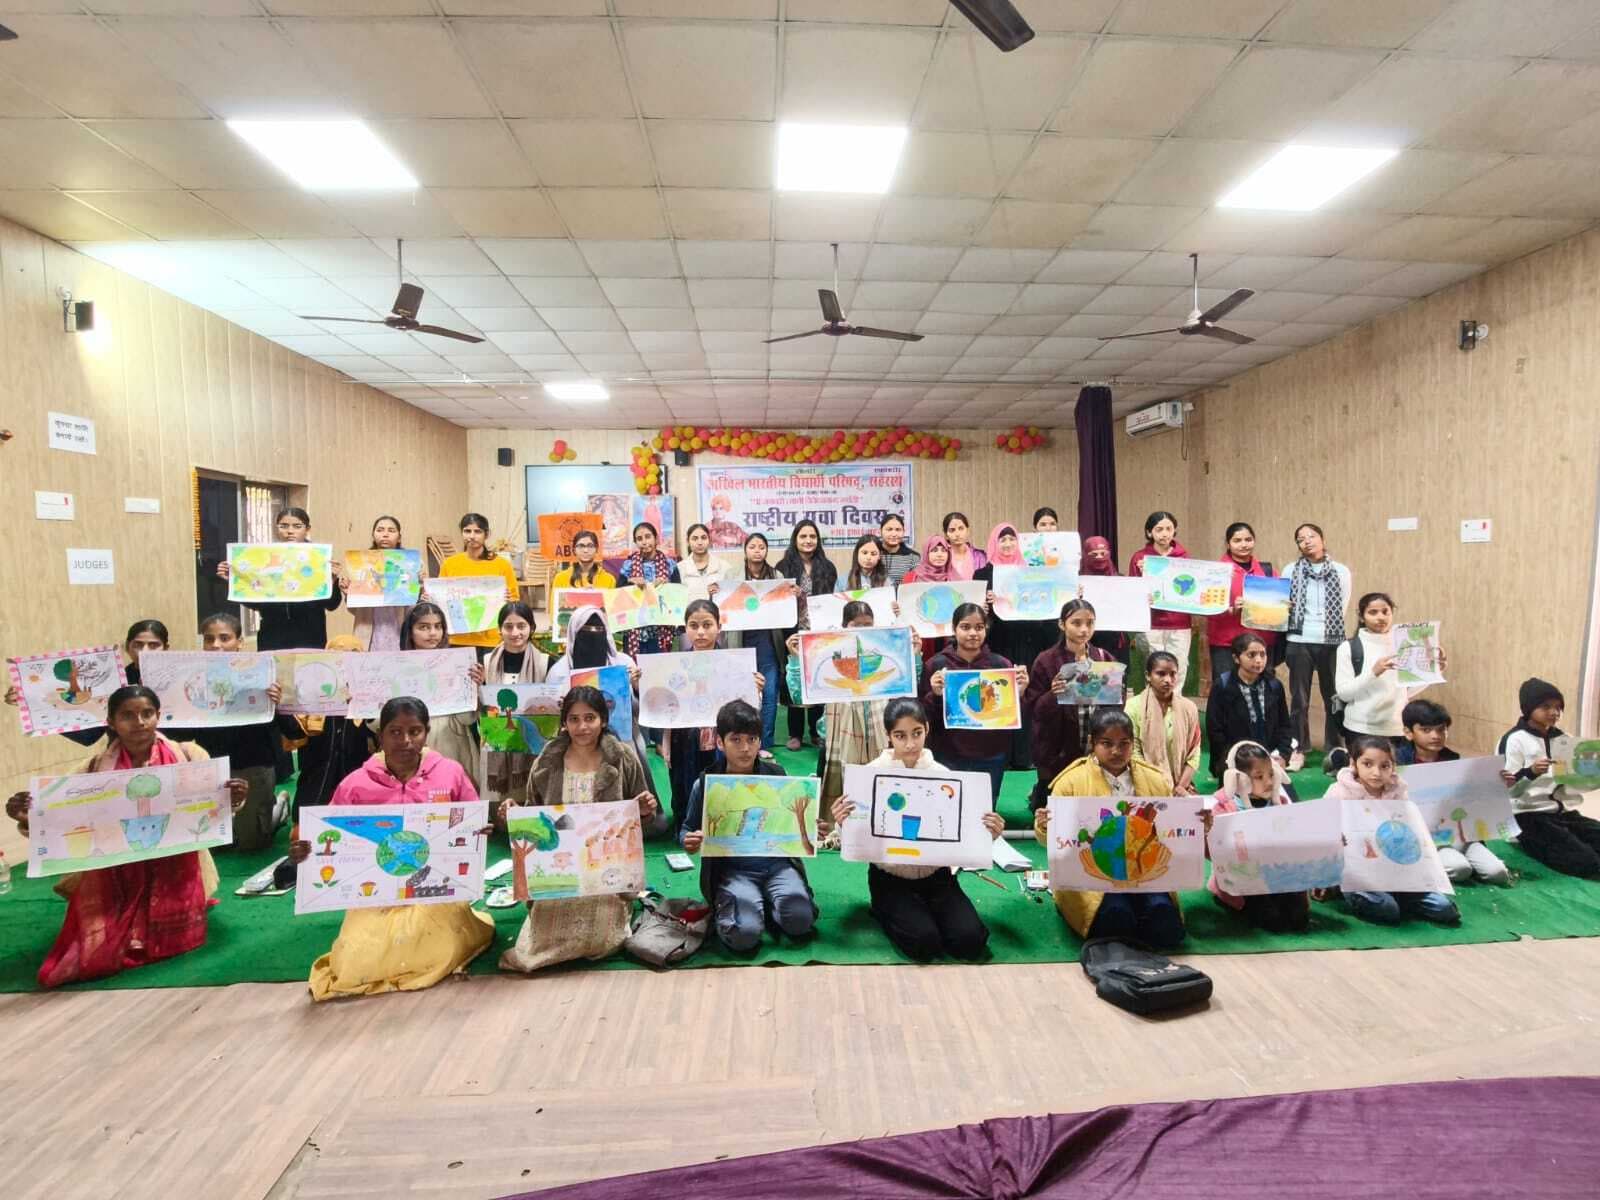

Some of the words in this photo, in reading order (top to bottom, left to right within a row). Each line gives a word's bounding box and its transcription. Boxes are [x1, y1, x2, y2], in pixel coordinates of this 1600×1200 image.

[748, 473, 786, 489] भारतीय
[743, 507, 798, 531] राष्ट्रीय
[802, 510, 836, 525] यवा
[842, 506, 889, 525] दिवस
[73, 560, 109, 569] JUDGES
